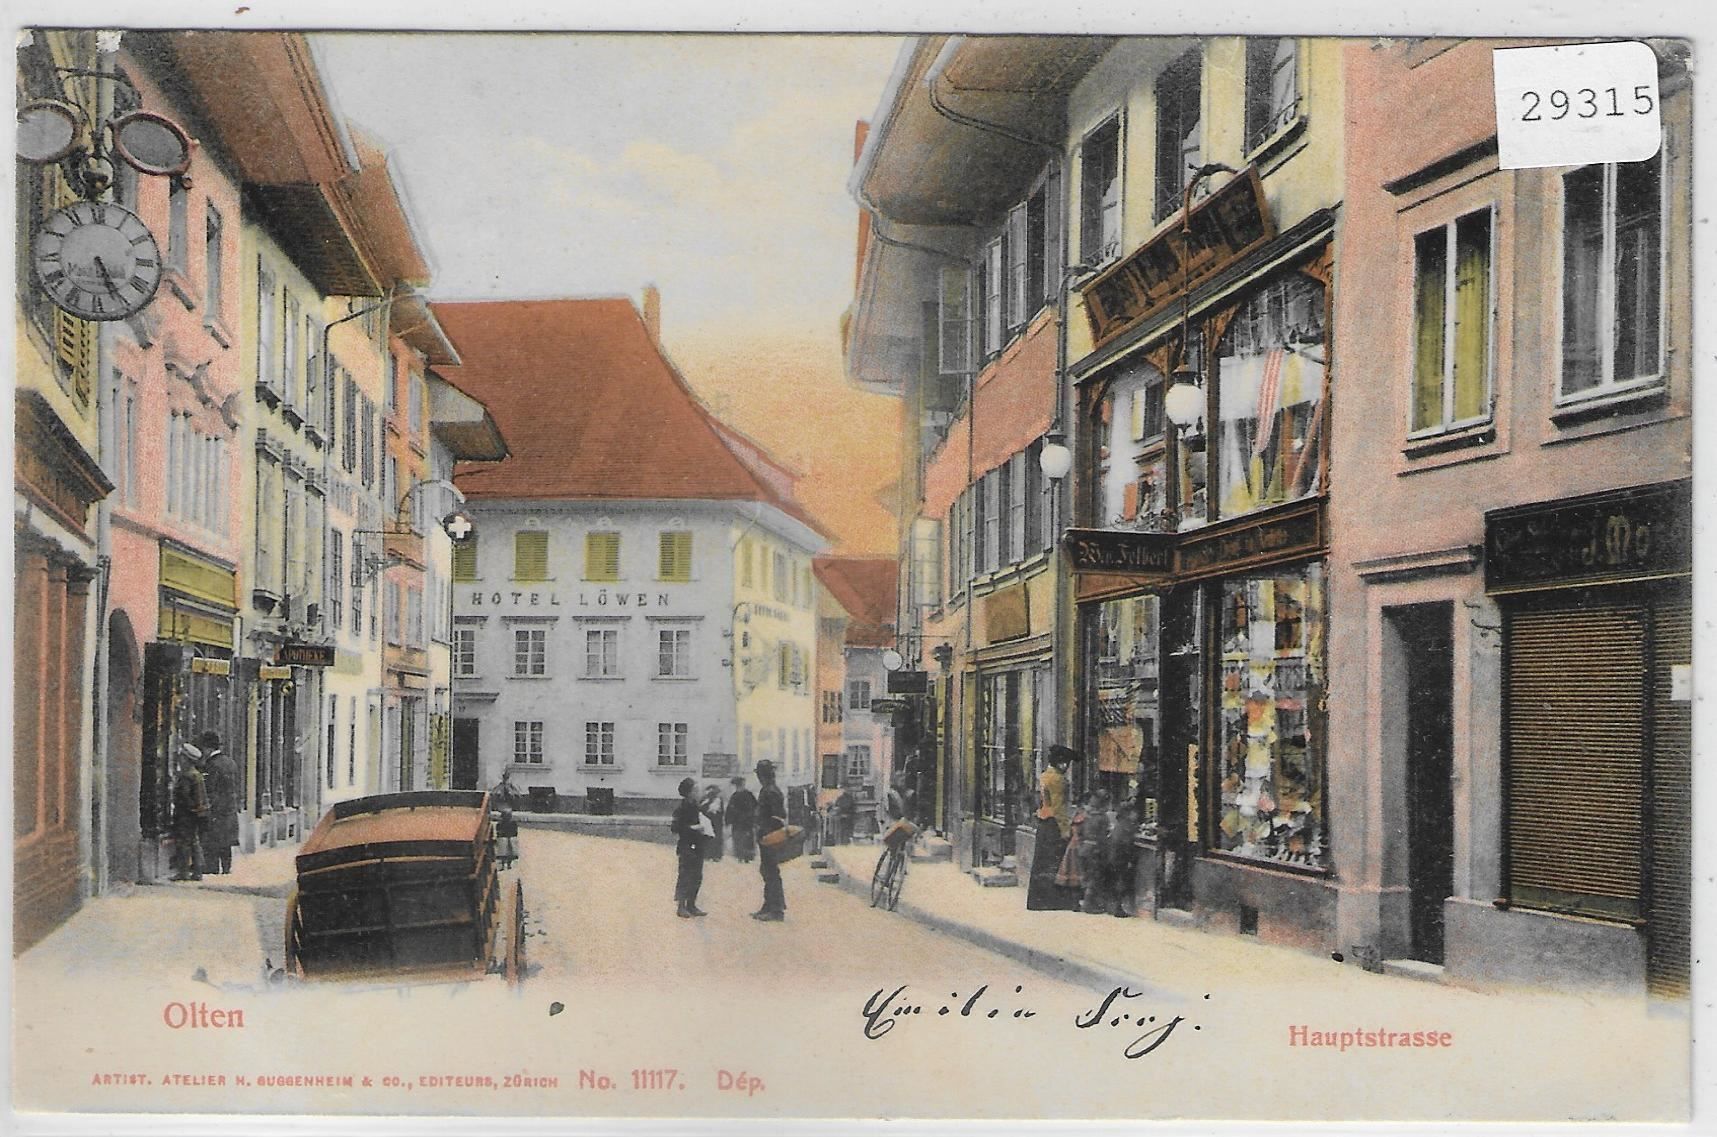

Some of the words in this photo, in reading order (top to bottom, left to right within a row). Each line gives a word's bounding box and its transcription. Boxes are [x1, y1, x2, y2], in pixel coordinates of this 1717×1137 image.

[1521, 85, 1653, 122] 29315
[471, 592, 560, 606] HOTEL
[579, 589, 669, 607] LÖWEN
